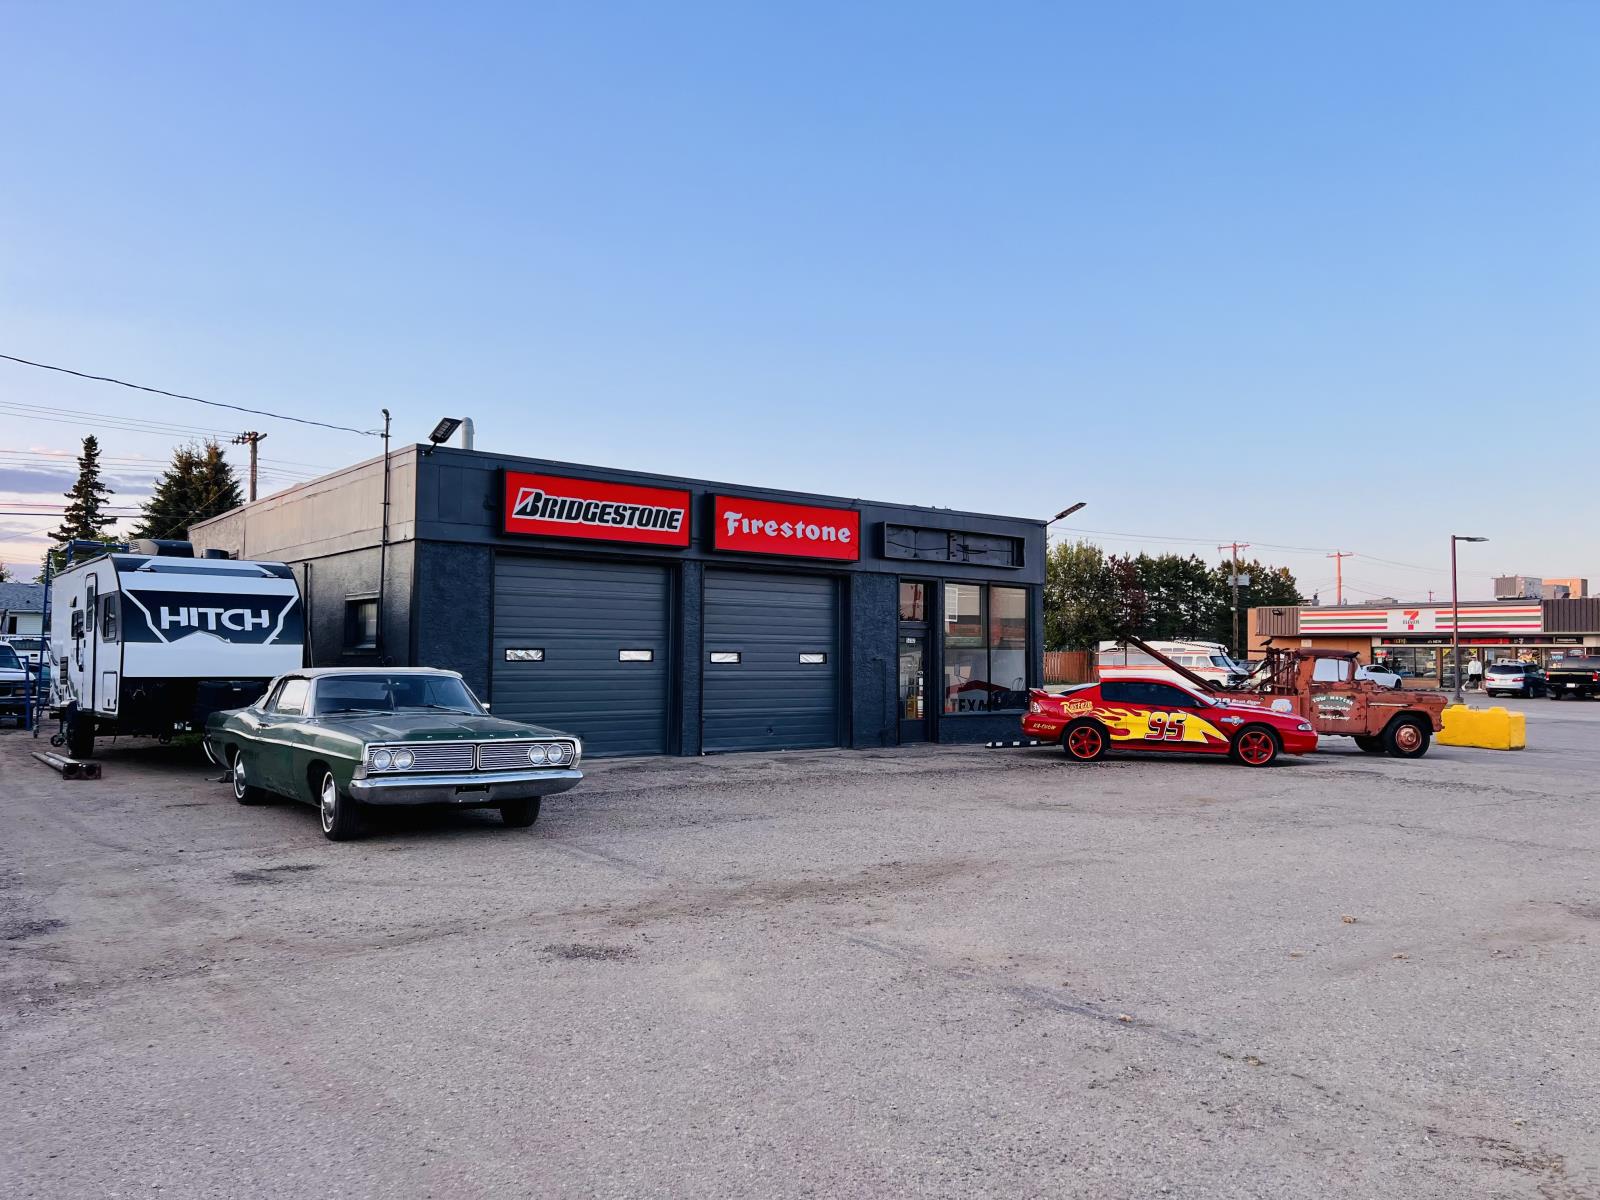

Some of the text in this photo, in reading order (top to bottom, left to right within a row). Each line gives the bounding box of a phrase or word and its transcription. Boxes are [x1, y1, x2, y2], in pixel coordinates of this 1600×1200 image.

[512, 487, 684, 532] BRIDGESTONE
[723, 511, 851, 543] Firestone
[160, 606, 270, 631] HITCH
[1403, 610, 1419, 631] 7
[1144, 711, 1187, 742] 95
